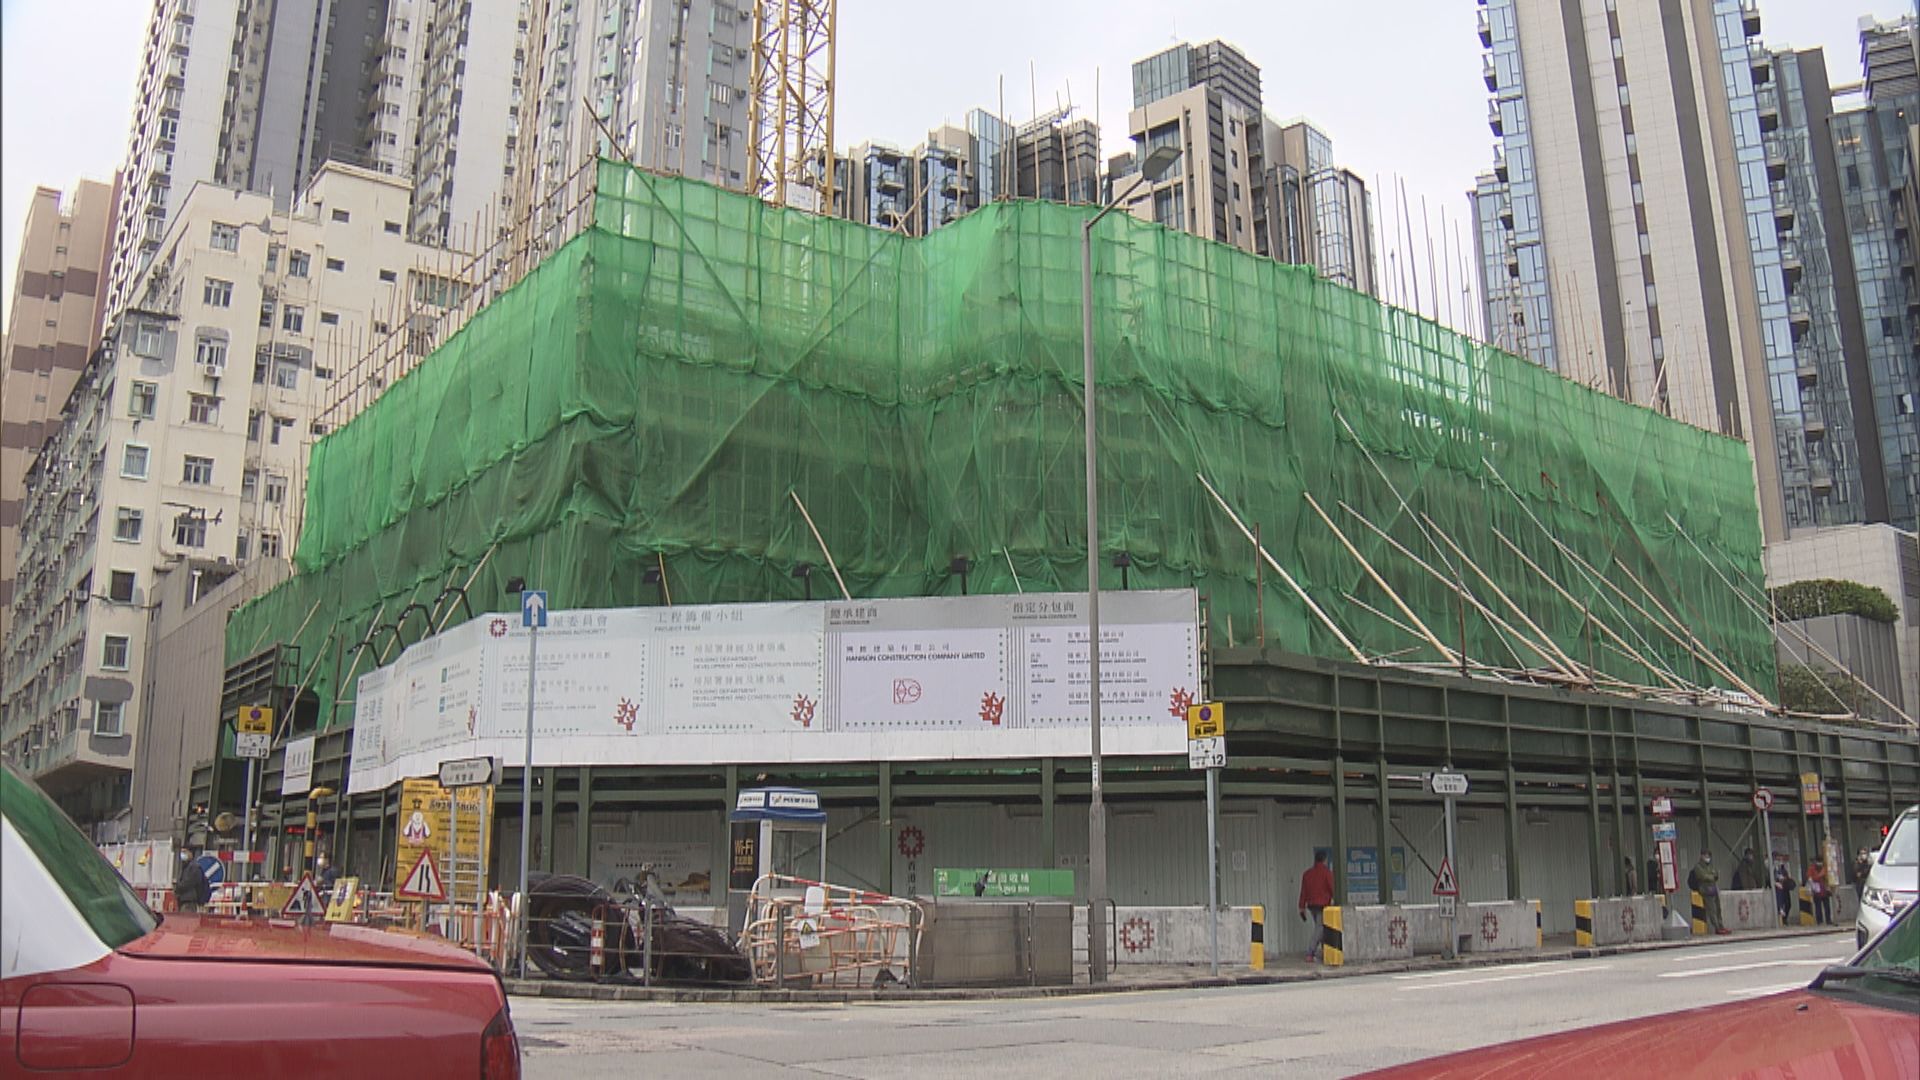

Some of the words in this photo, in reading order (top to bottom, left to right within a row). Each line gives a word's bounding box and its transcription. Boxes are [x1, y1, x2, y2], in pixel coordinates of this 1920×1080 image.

[1211, 738, 1217, 749] 7
[259, 748, 268, 757] 12
[1212, 754, 1223, 765] 12
